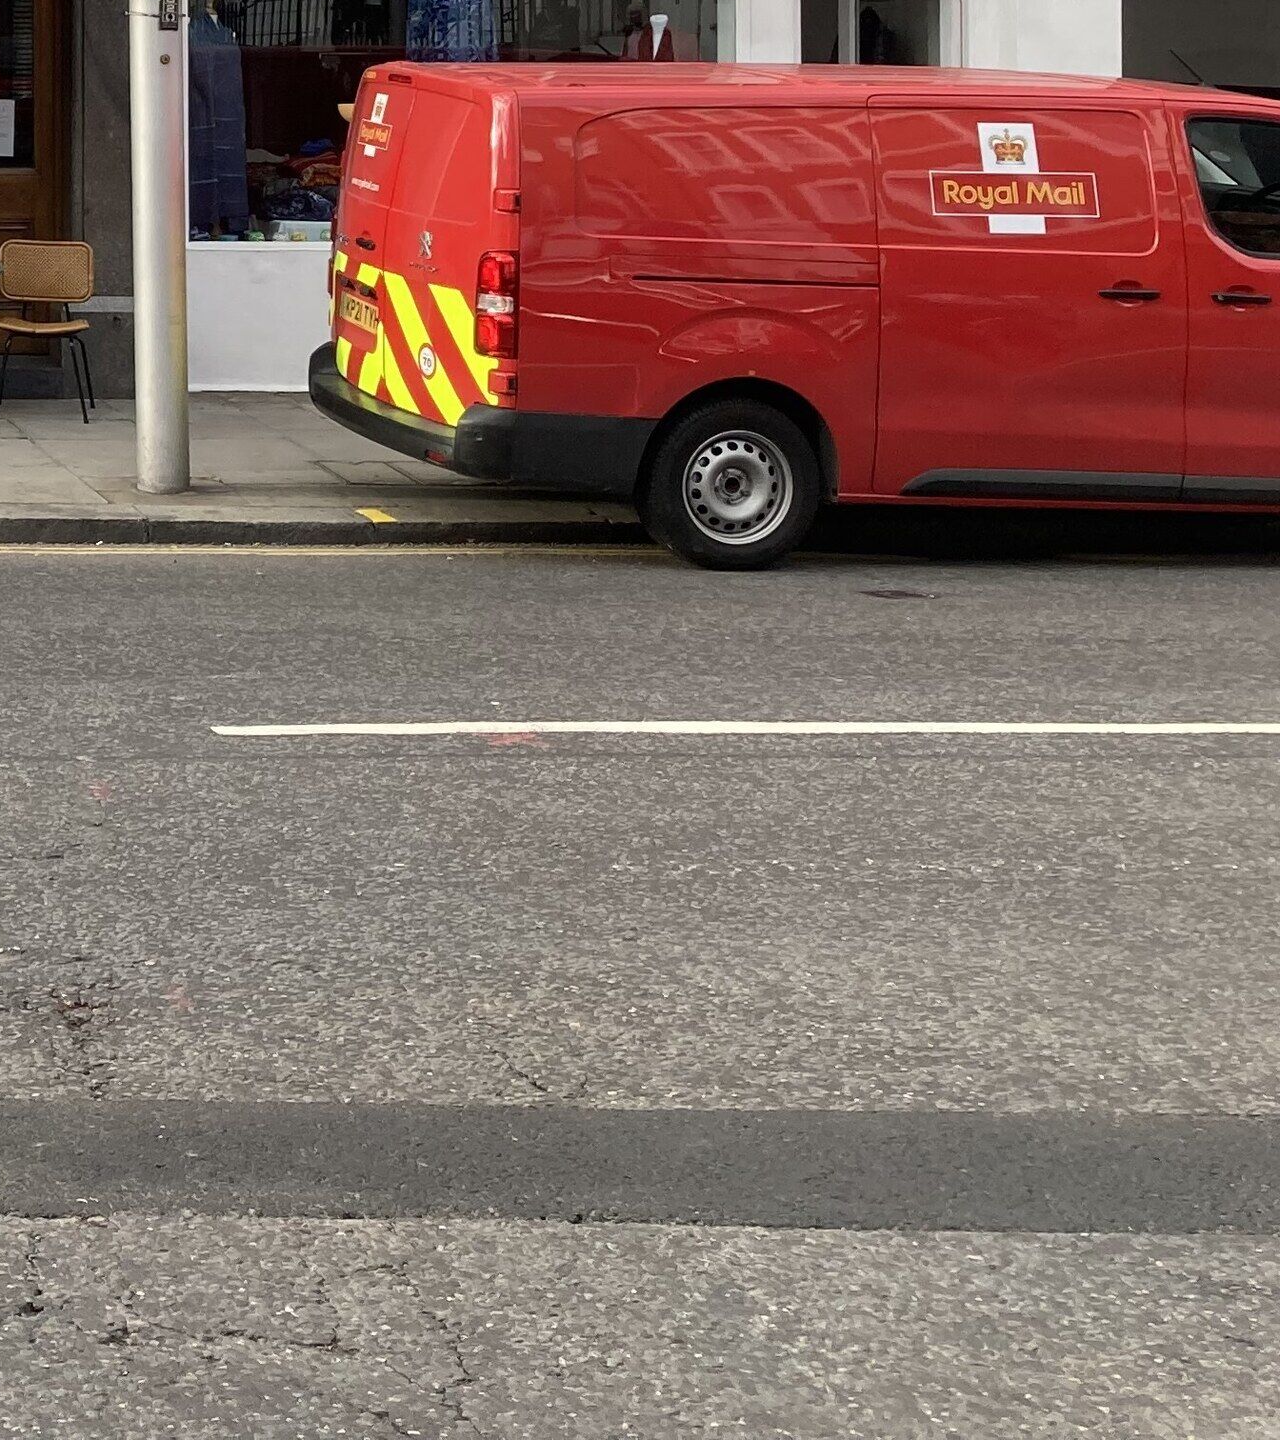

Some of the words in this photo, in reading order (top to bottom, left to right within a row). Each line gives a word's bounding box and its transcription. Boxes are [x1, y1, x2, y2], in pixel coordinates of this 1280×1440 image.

[943, 180, 1019, 210] Royal
[1026, 181, 1086, 205] Mail
[423, 356, 432, 368] 70
